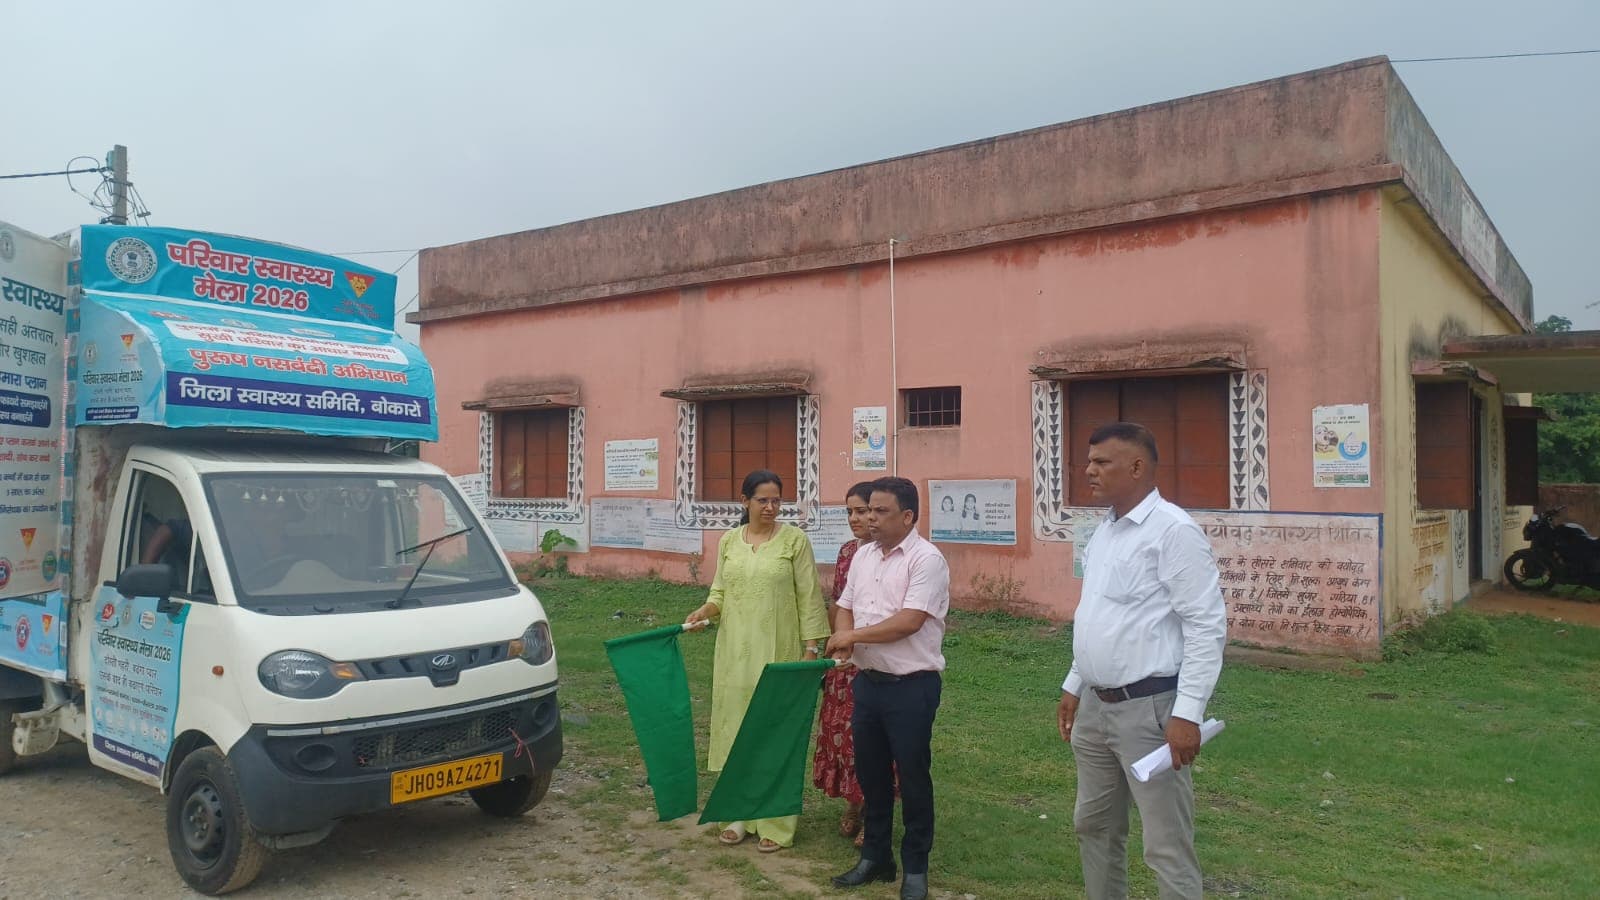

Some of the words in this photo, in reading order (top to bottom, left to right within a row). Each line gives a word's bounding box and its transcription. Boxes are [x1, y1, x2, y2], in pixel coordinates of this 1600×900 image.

[168, 239, 251, 274] परिवार
[254, 259, 334, 288] स्वास्थ्य
[1, 277, 66, 315] स्वास्थ्य
[194, 272, 248, 303] मेला
[254, 285, 309, 311] 2026
[333, 363, 408, 385] अभियान
[179, 377, 233, 403] जिला
[237, 384, 302, 408] स्वास्थ्य
[306, 386, 365, 415] समिति,
[370, 396, 422, 418] बोकारो
[1251, 555, 1277, 569] तीसरे
[1316, 557, 1333, 570] को
[154, 645, 171, 661] 2026
[405, 759, 500, 794] JH09AZ4271
